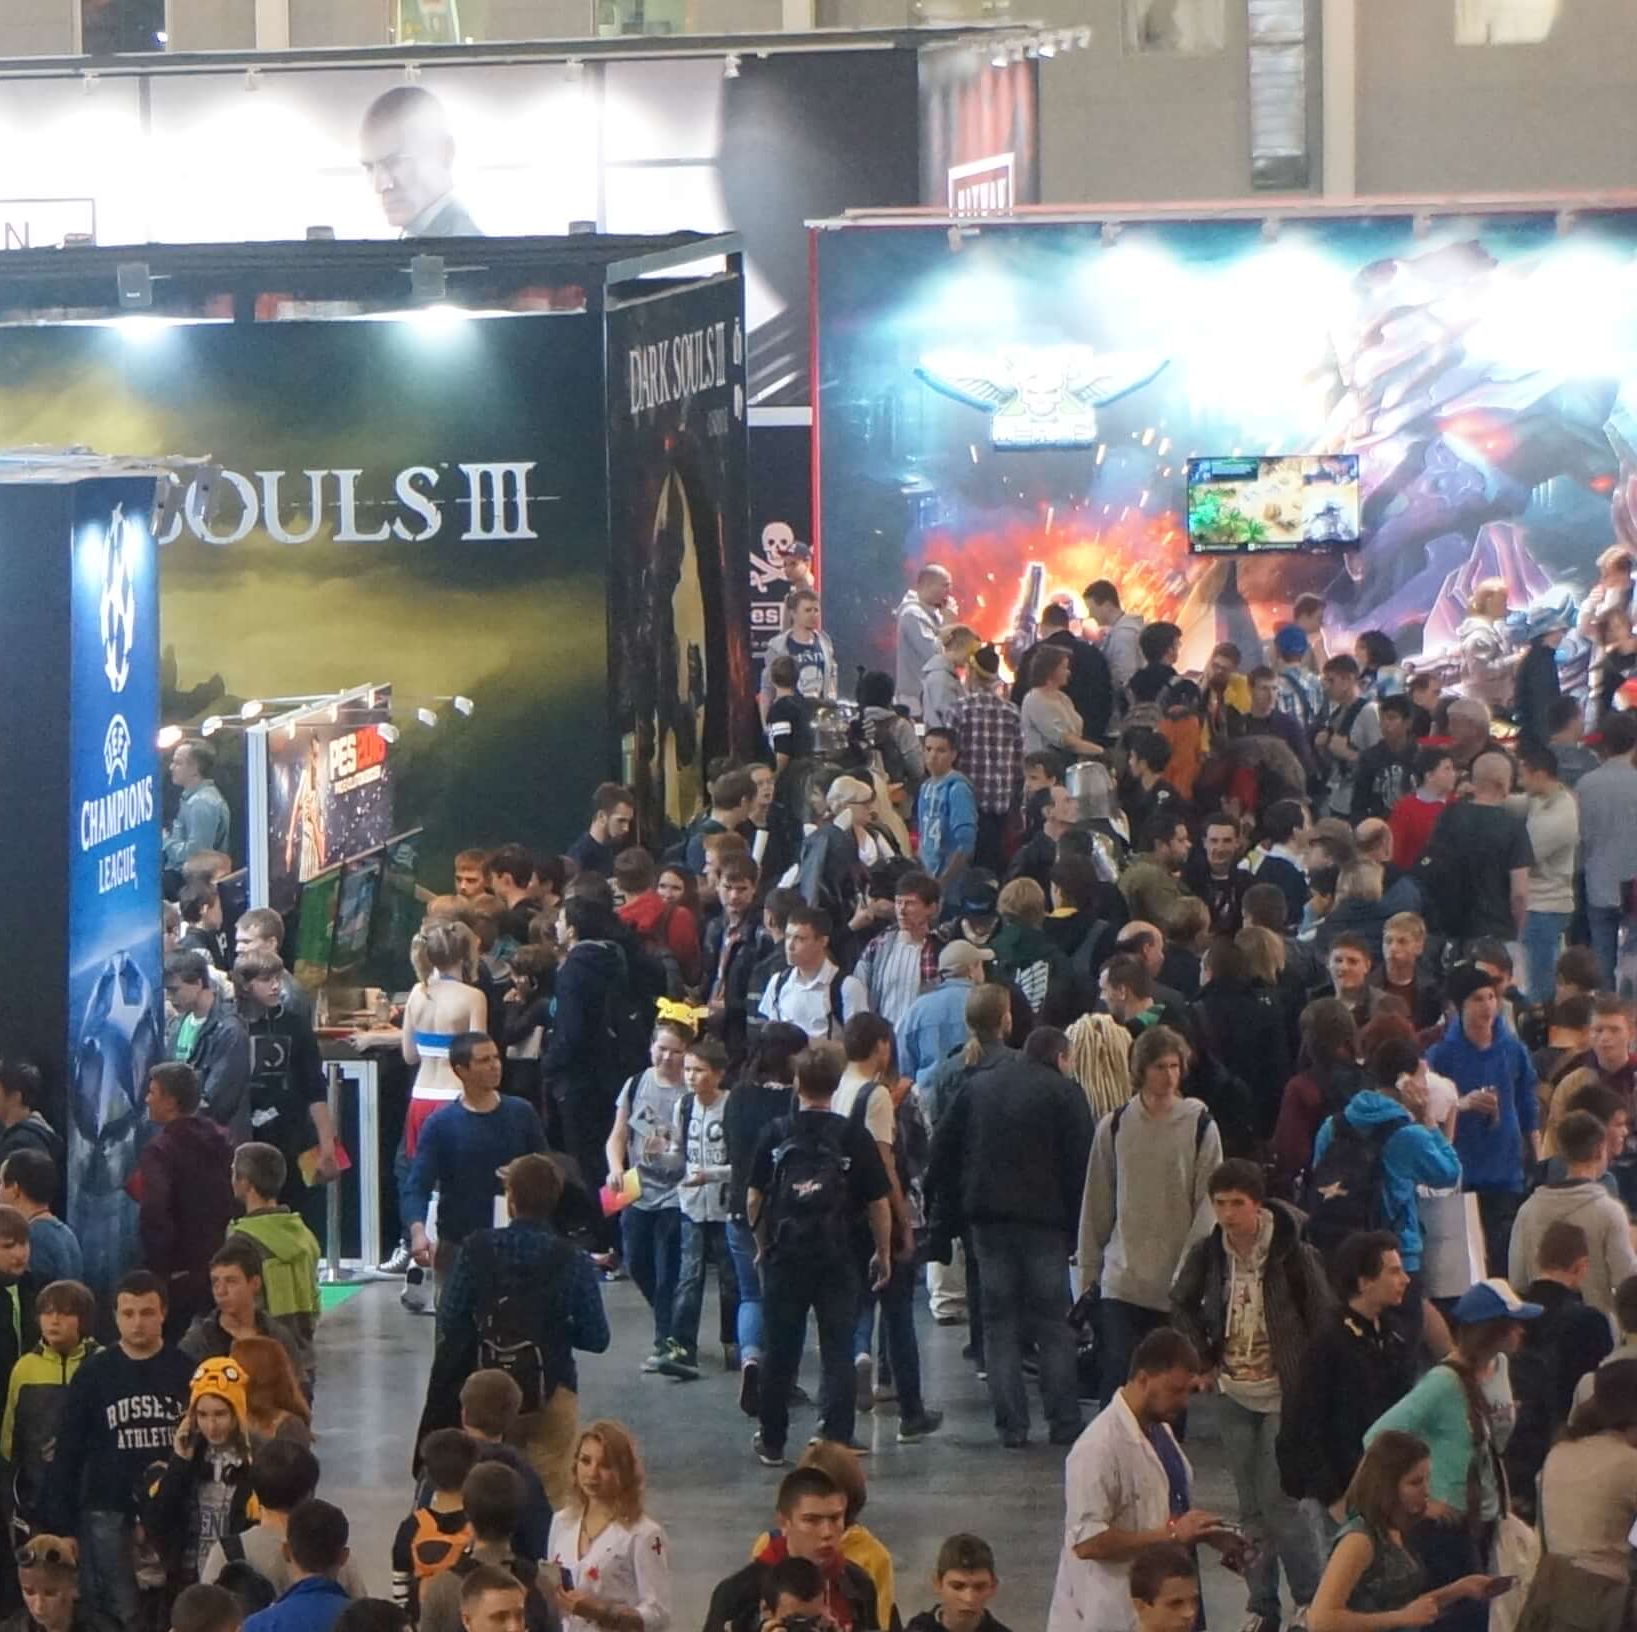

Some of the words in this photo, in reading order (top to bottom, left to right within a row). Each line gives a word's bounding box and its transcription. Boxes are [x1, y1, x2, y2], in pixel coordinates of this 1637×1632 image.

[629, 340, 671, 414] DARK
[673, 325, 715, 401] SOULS
[458, 462, 538, 541] III
[328, 732, 356, 783] PES
[80, 775, 153, 852] CHAMPIONS
[98, 844, 137, 895] LEAGUE
[117, 1425, 175, 1450] ATHLETI
